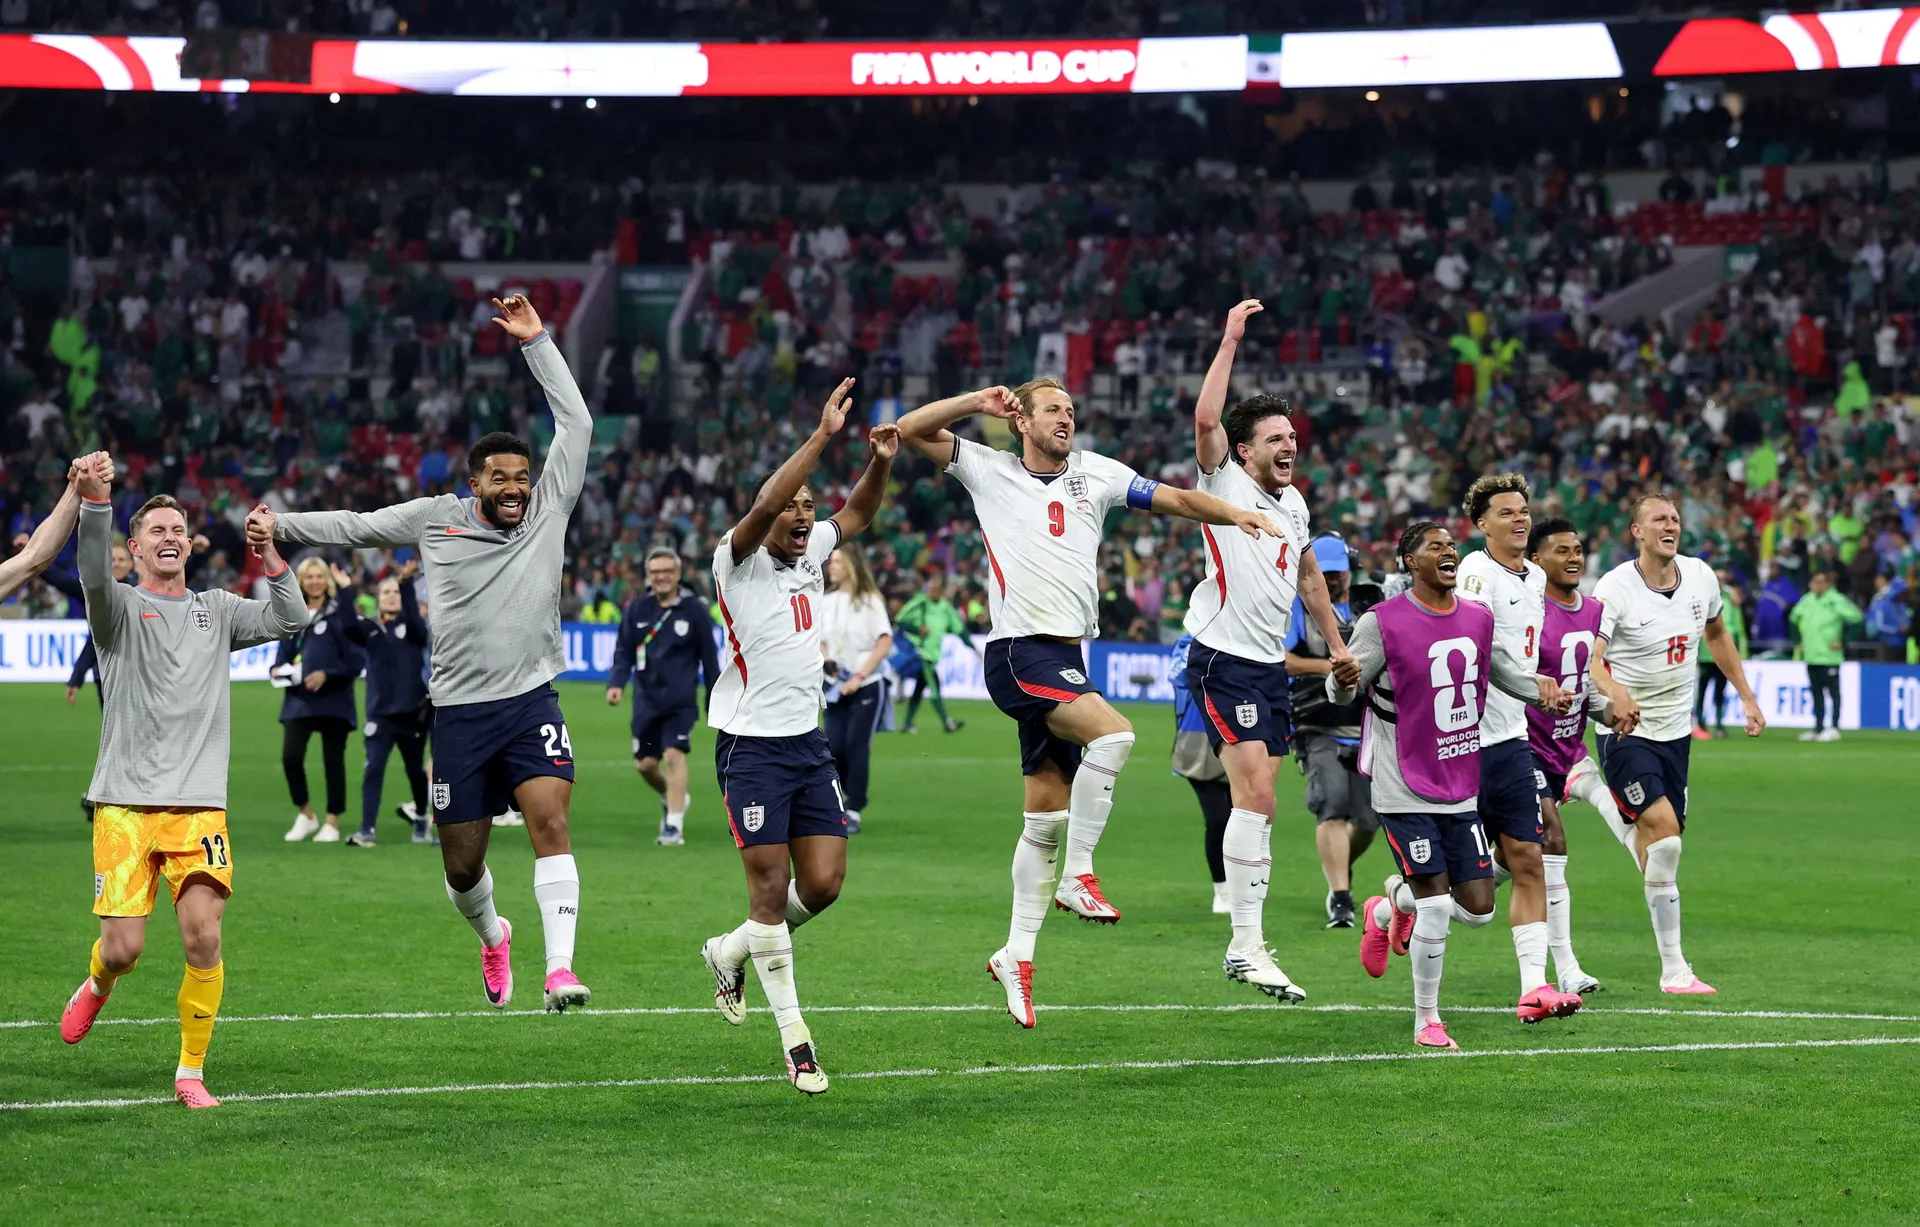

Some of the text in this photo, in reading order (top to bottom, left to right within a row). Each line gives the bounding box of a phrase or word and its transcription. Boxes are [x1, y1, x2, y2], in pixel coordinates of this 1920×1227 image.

[851, 50, 1136, 85] FIFA WORLD CUP
[1047, 501, 1065, 537] 9
[1276, 543, 1288, 577] 4
[790, 593, 812, 633] 10
[1524, 626, 1534, 657] 3
[1667, 635, 1688, 665] 15
[1778, 685, 1814, 715] FIF
[1450, 710, 1468, 723] FIFA
[1552, 723, 1579, 739] 202
[540, 723, 573, 758] 24
[1437, 730, 1480, 746] WORLD CUP
[1437, 739, 1480, 760] 2026
[200, 834, 228, 867] 13
[558, 906, 577, 915] ENG
